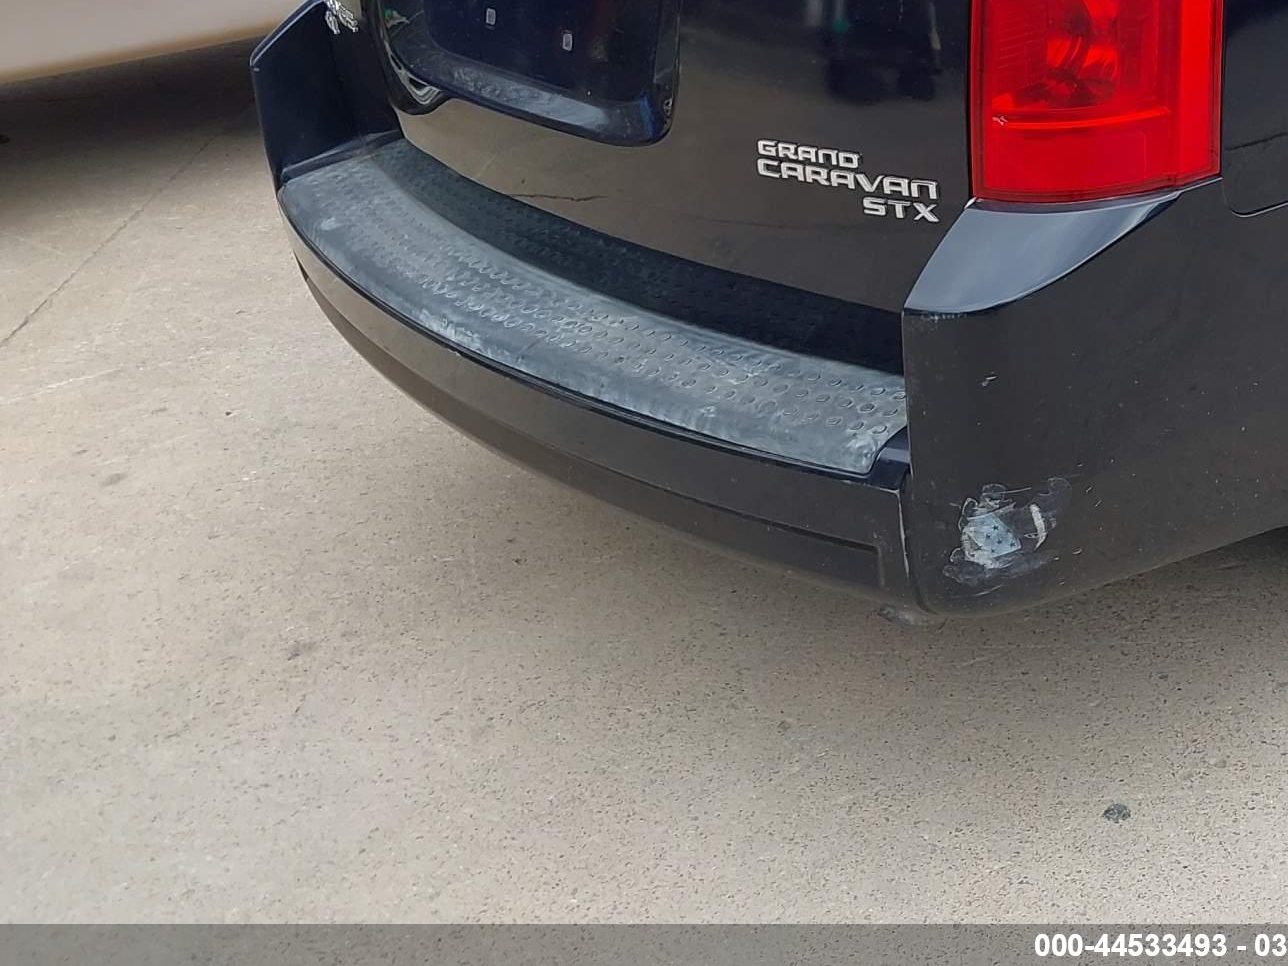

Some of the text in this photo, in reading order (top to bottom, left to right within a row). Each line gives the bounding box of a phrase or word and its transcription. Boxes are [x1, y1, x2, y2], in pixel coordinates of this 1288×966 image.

[757, 139, 861, 169] GRAND
[757, 158, 939, 200] CARAVAN
[863, 196, 940, 223] STX
